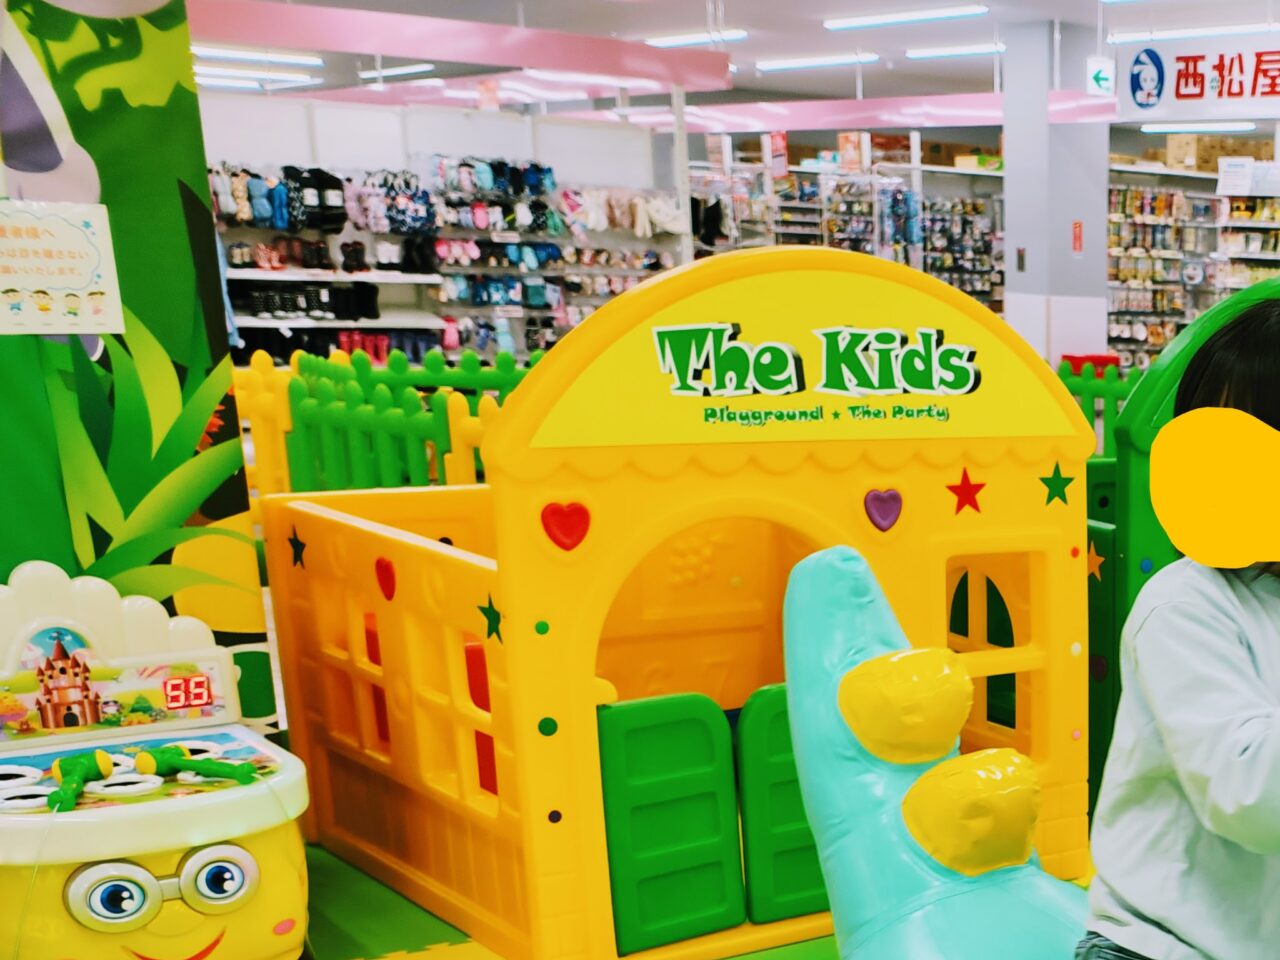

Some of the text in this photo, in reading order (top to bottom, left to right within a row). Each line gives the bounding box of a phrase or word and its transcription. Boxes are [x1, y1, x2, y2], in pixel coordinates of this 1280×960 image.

[652, 322, 981, 397] The Kids
[703, 405, 949, 426] Playground The Party
